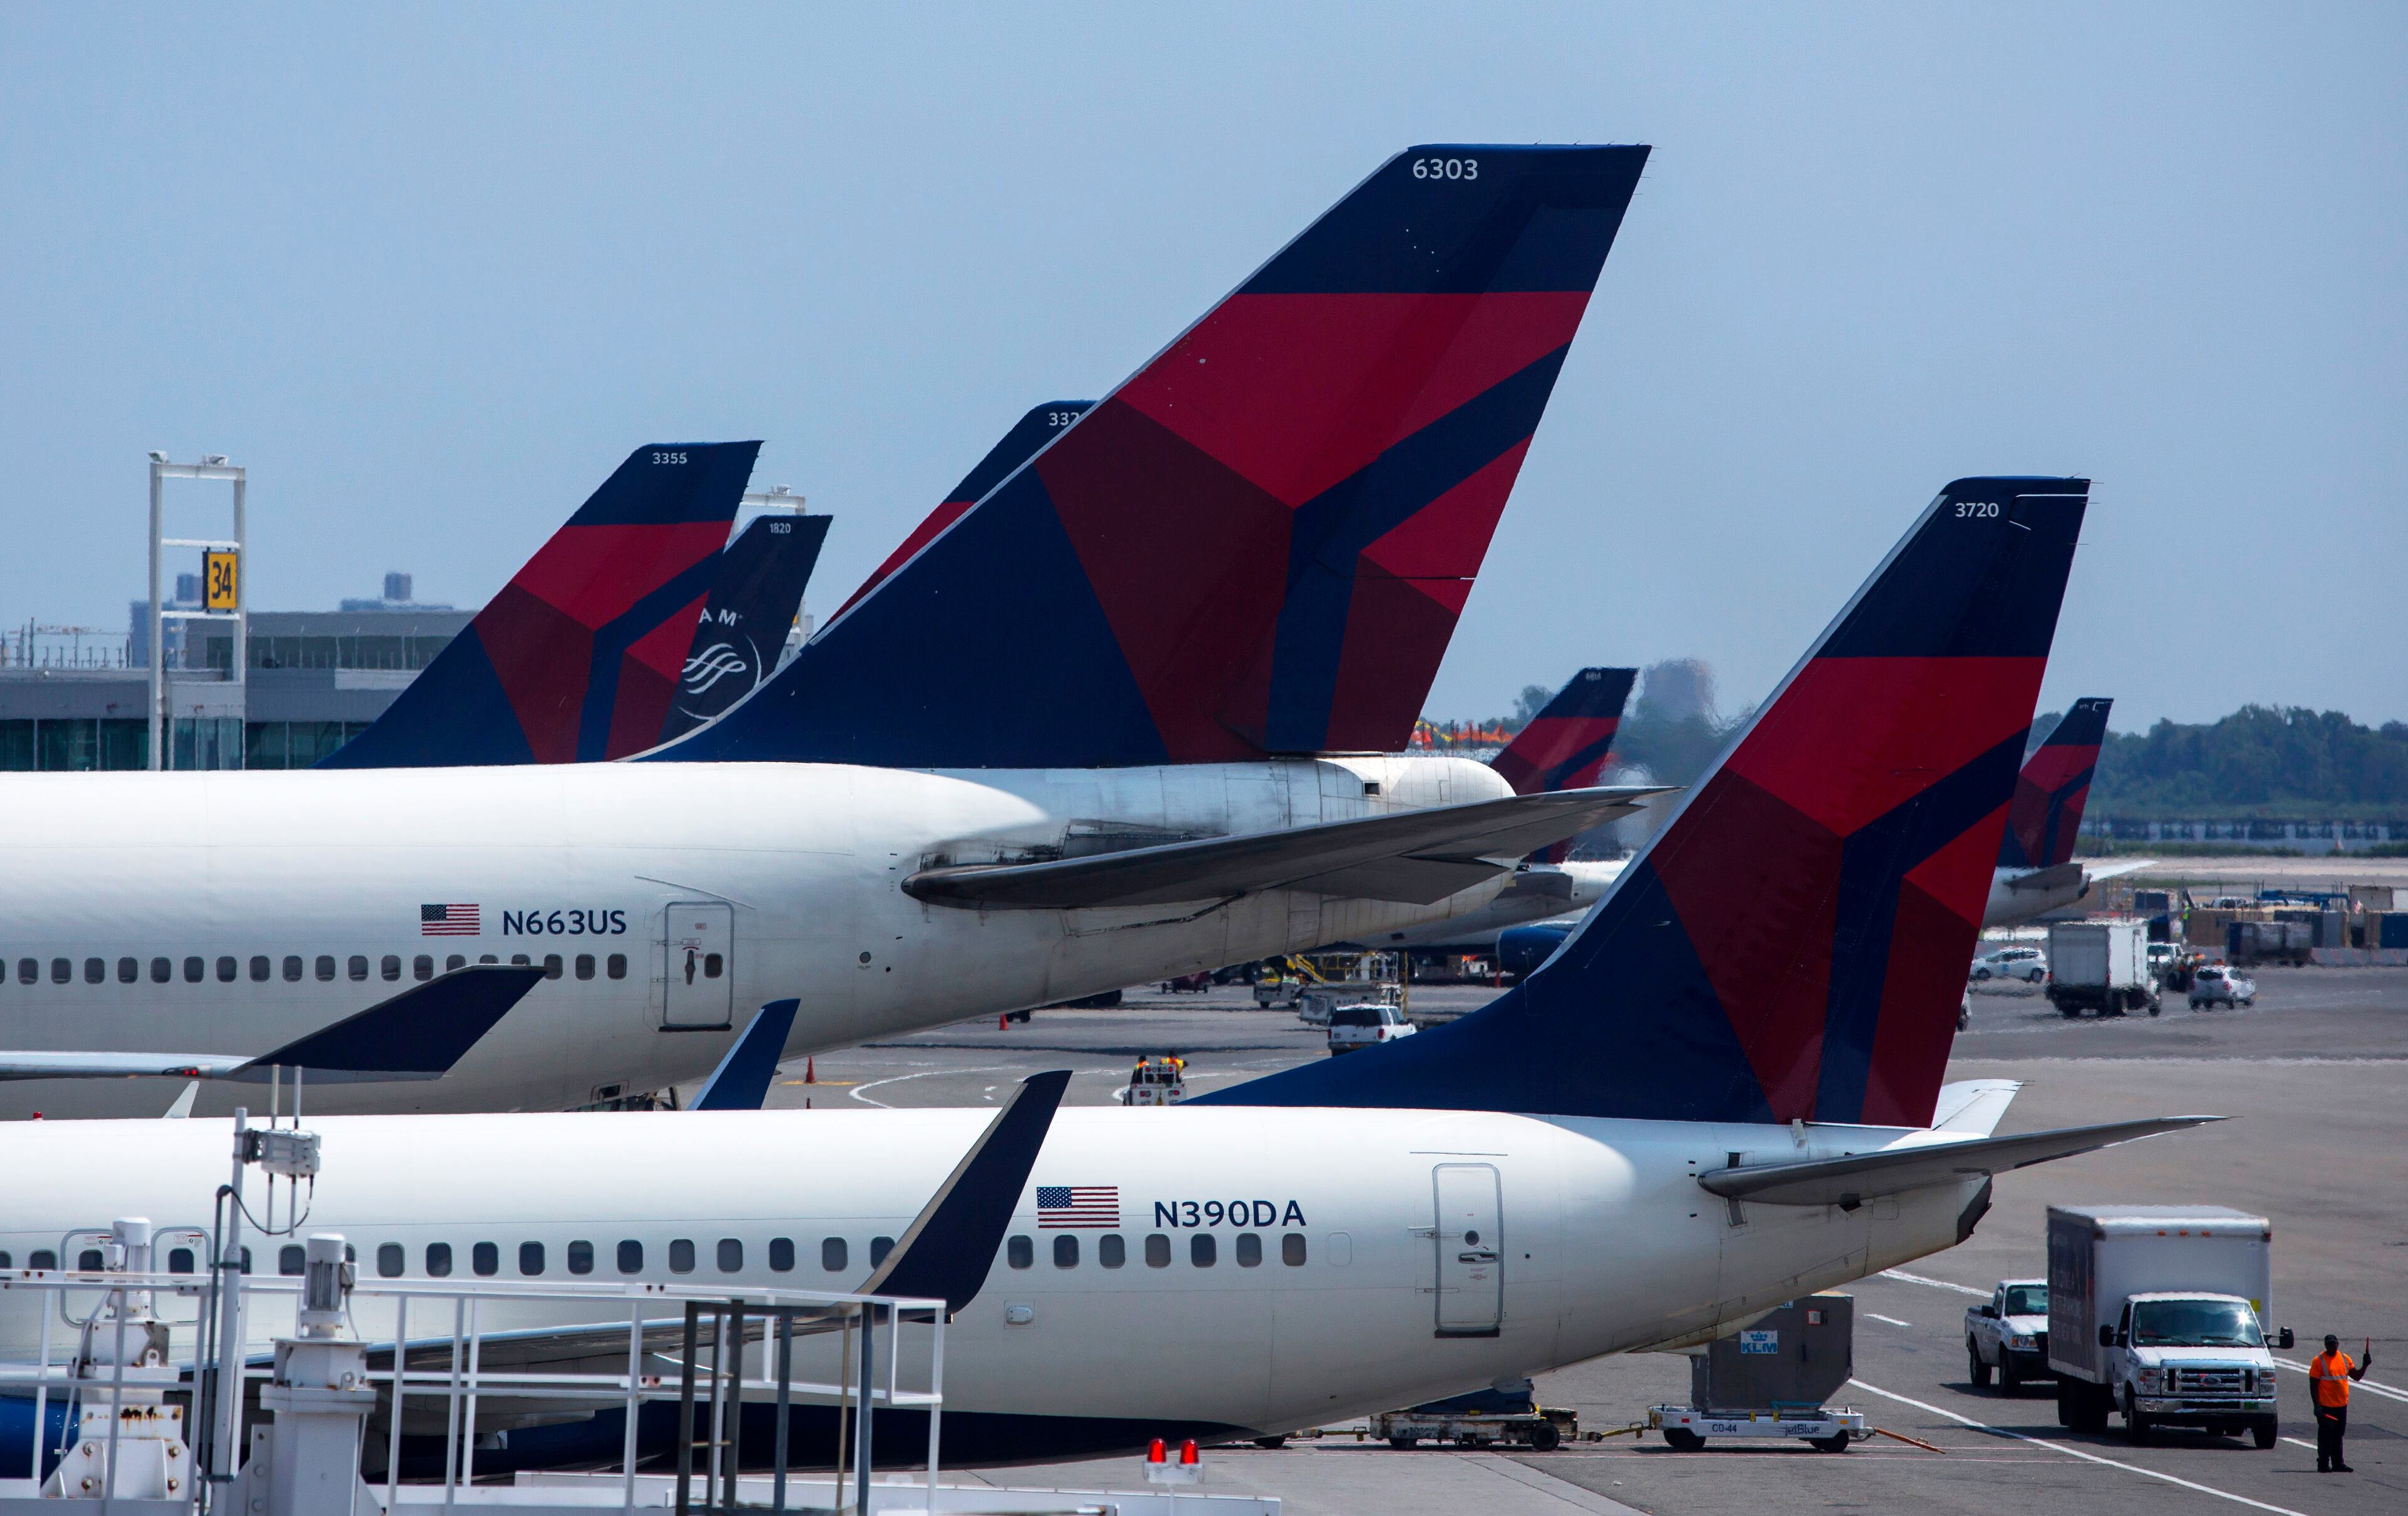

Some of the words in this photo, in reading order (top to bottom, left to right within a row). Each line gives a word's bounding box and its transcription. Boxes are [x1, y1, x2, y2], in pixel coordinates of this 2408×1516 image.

[1413, 158, 1478, 180] 6303
[652, 452, 687, 464] 3355
[1955, 502, 1999, 517] 3720
[770, 522, 791, 533] 1820
[212, 561, 231, 600] 34
[503, 909, 626, 935] N663US
[1154, 1200, 1307, 1227] N390DA
[1741, 1342, 1777, 1353] KLM
